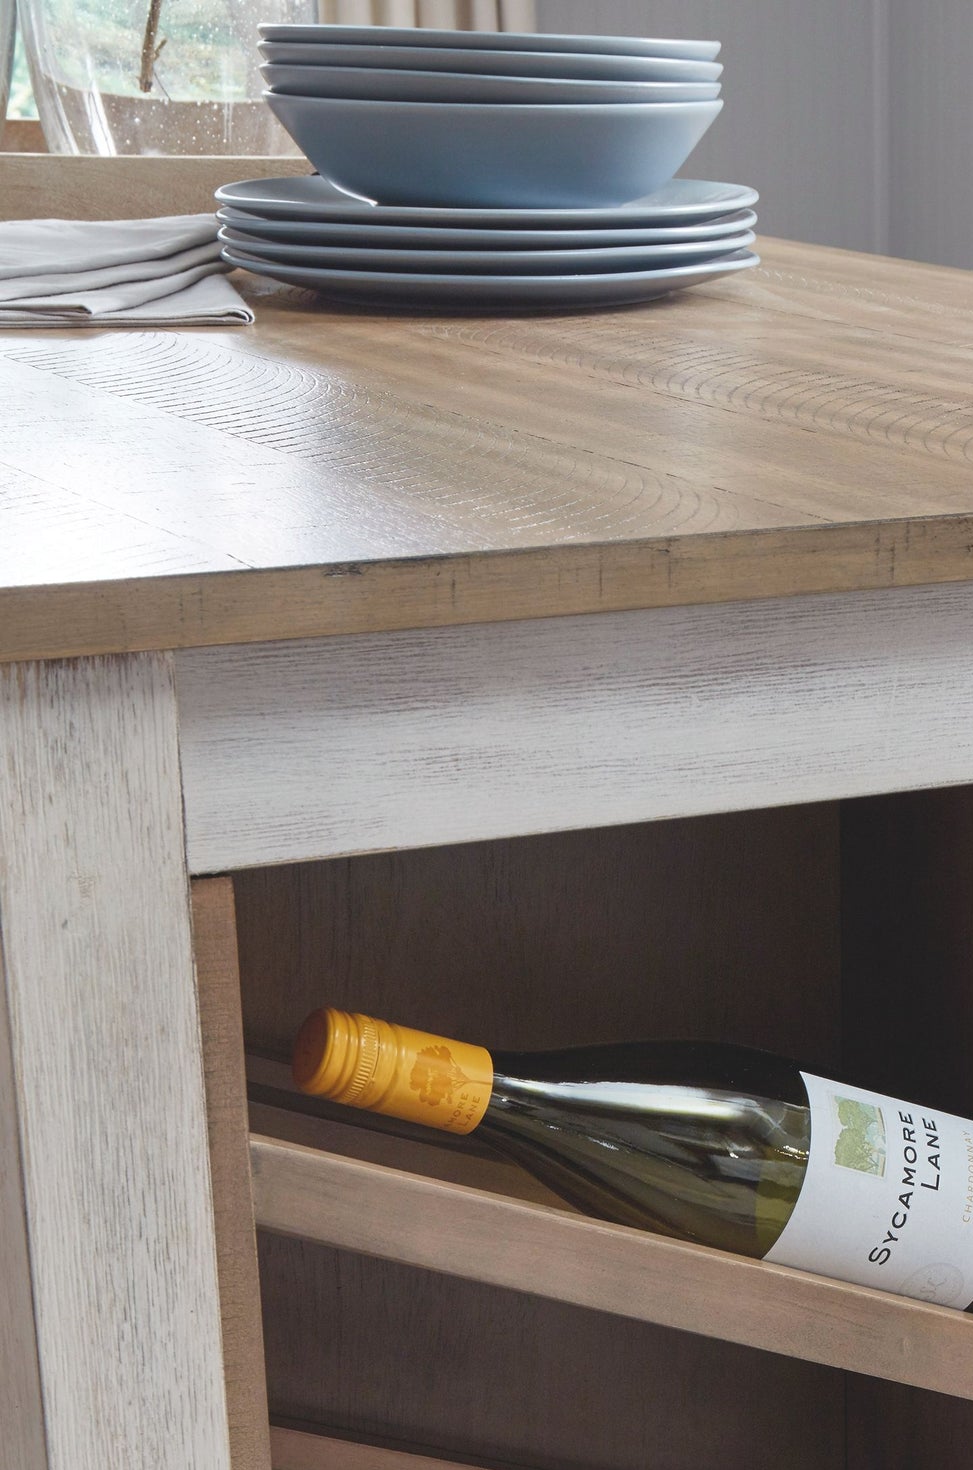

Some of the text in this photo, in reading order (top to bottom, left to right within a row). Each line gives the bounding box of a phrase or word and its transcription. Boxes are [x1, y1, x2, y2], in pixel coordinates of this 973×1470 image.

[456, 1095, 481, 1127] LANE
[868, 1110, 917, 1266] SYCAMORE
[920, 1117, 941, 1191] LANE
